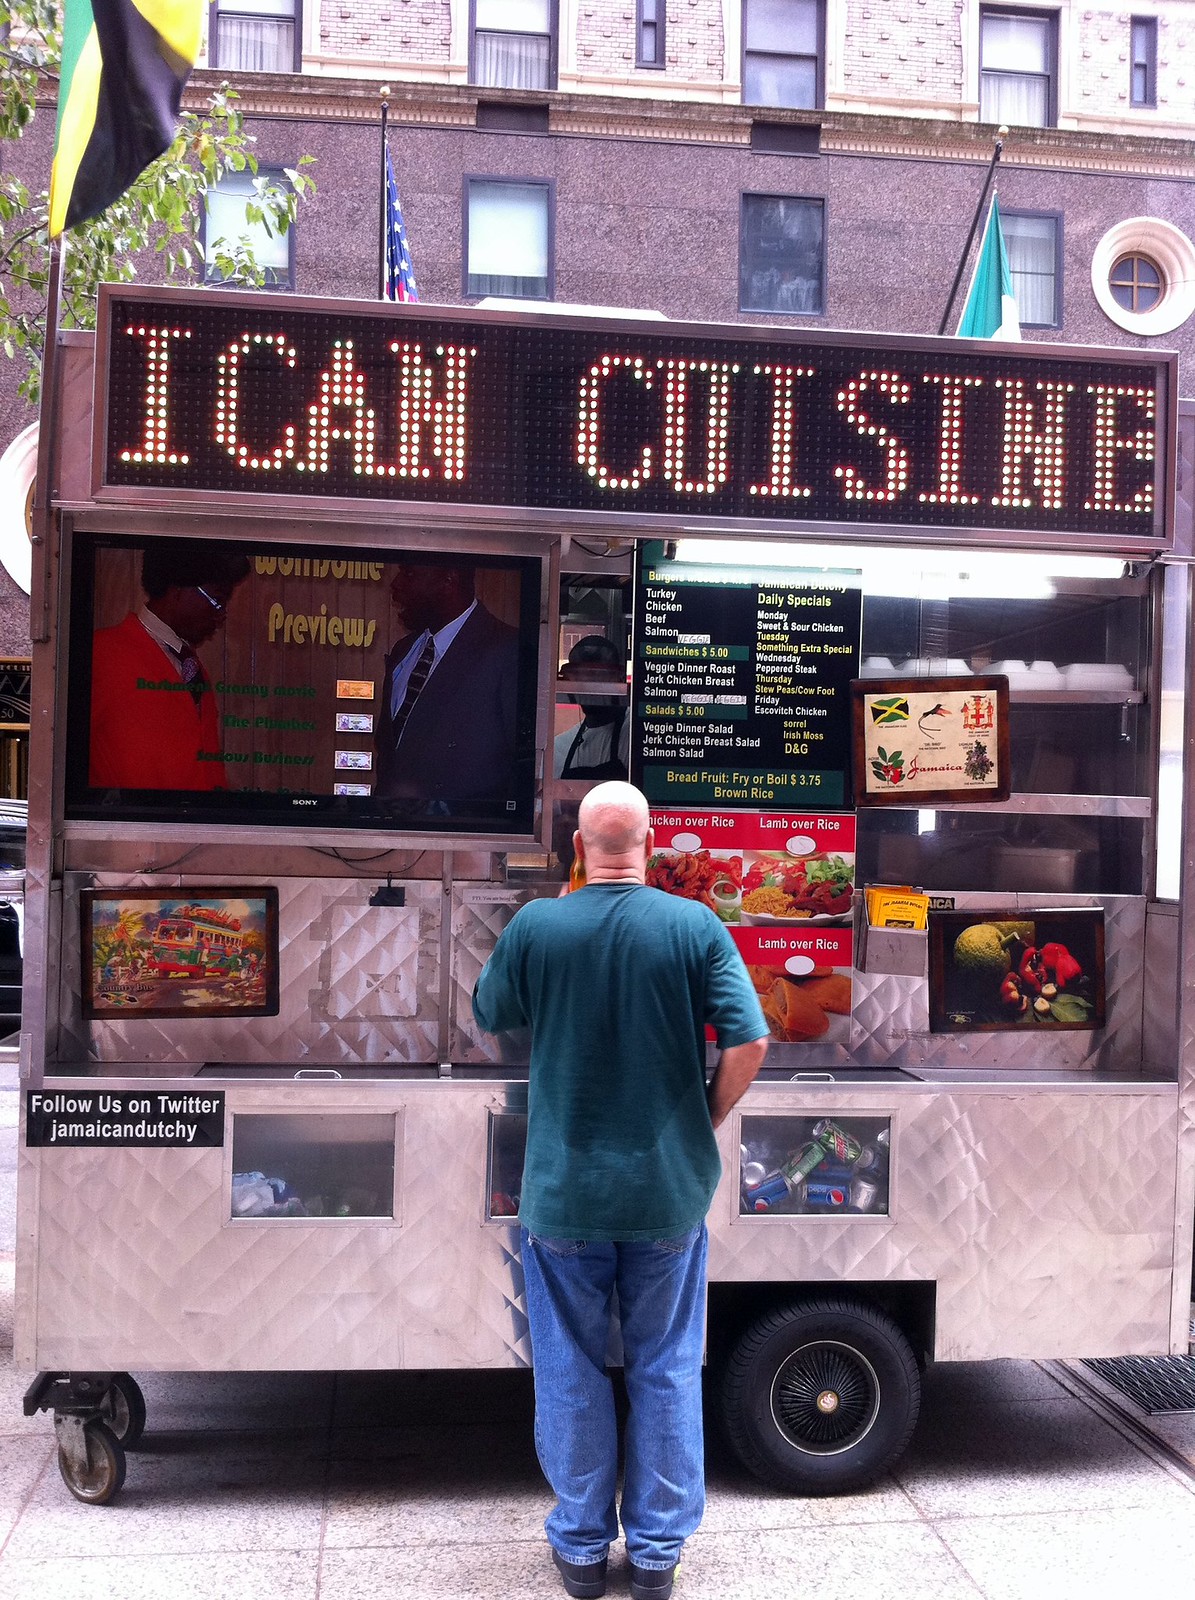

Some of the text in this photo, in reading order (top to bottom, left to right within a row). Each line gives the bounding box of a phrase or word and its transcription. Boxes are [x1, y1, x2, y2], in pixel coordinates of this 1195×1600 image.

[120, 326, 1155, 514] ICAN CUISINE
[646, 588, 677, 601] Turkey
[757, 592, 832, 608] Daily Specials
[645, 601, 683, 612] Chicken
[645, 613, 667, 624] Beef
[757, 610, 789, 621] Monday
[268, 602, 377, 647] Previews
[756, 621, 844, 633] Sweet & Sour Chicken
[644, 626, 679, 637] Salmon
[756, 631, 790, 643] Tuesday
[645, 645, 729, 658] Sandwiches $ 5.00
[756, 642, 853, 655] Something Extra Special
[755, 653, 801, 664] Wednesday
[644, 661, 736, 674] Veggie Dinner Roast
[755, 663, 817, 674] Peppered Steak
[644, 674, 735, 687] Jerk Chicken Breast
[755, 674, 793, 685] Thursday
[644, 686, 678, 697] Salmon
[755, 684, 836, 696] Stew Peas/Cow Foot
[754, 695, 780, 706] Friday
[645, 705, 705, 717] Salads $ 5.00
[754, 705, 827, 716] Escovitch Chicken
[643, 721, 734, 734] Veggie Dinner Salad
[783, 719, 807, 728] sorrel
[642, 734, 761, 747] Jerk Chicken Breast Salad
[783, 730, 824, 740] Irish Moss
[642, 747, 704, 758] Salmon Salad
[784, 743, 809, 754] D&G
[906, 754, 963, 780] Jamaica
[667, 771, 821, 786] Bread Fruit: Fry or Boil $ 3.75
[714, 786, 774, 799] Brown Rice
[649, 814, 735, 828] hicken over Rice
[759, 817, 841, 830] Lamb over Rice
[758, 937, 840, 950] Lamb over Rice
[31, 1095, 220, 1114] Follow Us on Twitter
[50, 1119, 198, 1142] jamaicandutchy
